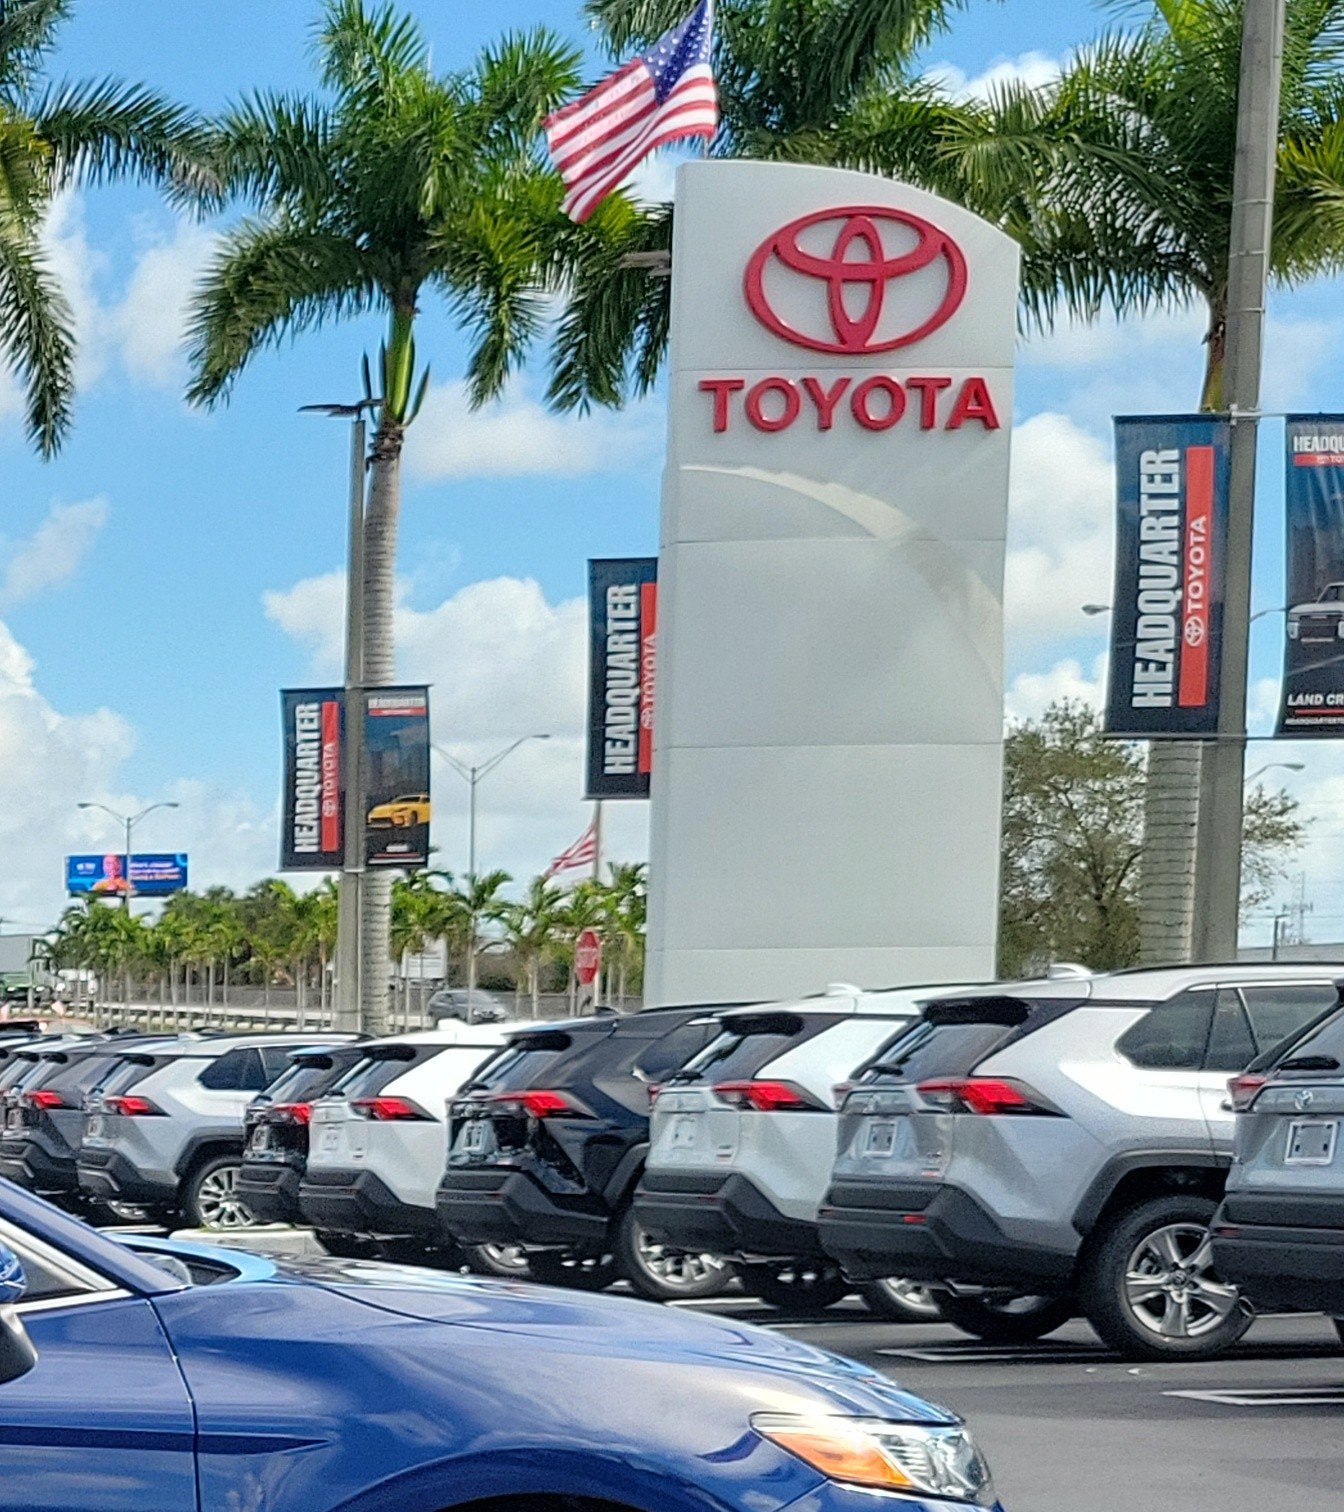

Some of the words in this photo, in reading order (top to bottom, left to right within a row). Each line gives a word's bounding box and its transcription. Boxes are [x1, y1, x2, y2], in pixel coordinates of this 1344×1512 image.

[698, 375, 1001, 433] TOYOTA
[1132, 448, 1183, 708] HEADQUARTER
[1185, 514, 1207, 614] TOYOTA
[603, 583, 640, 775] HEADQUARTER
[1286, 693, 1324, 706] LAND
[294, 702, 322, 853] HEADQUARTER
[323, 743, 337, 799] TOYOTA
